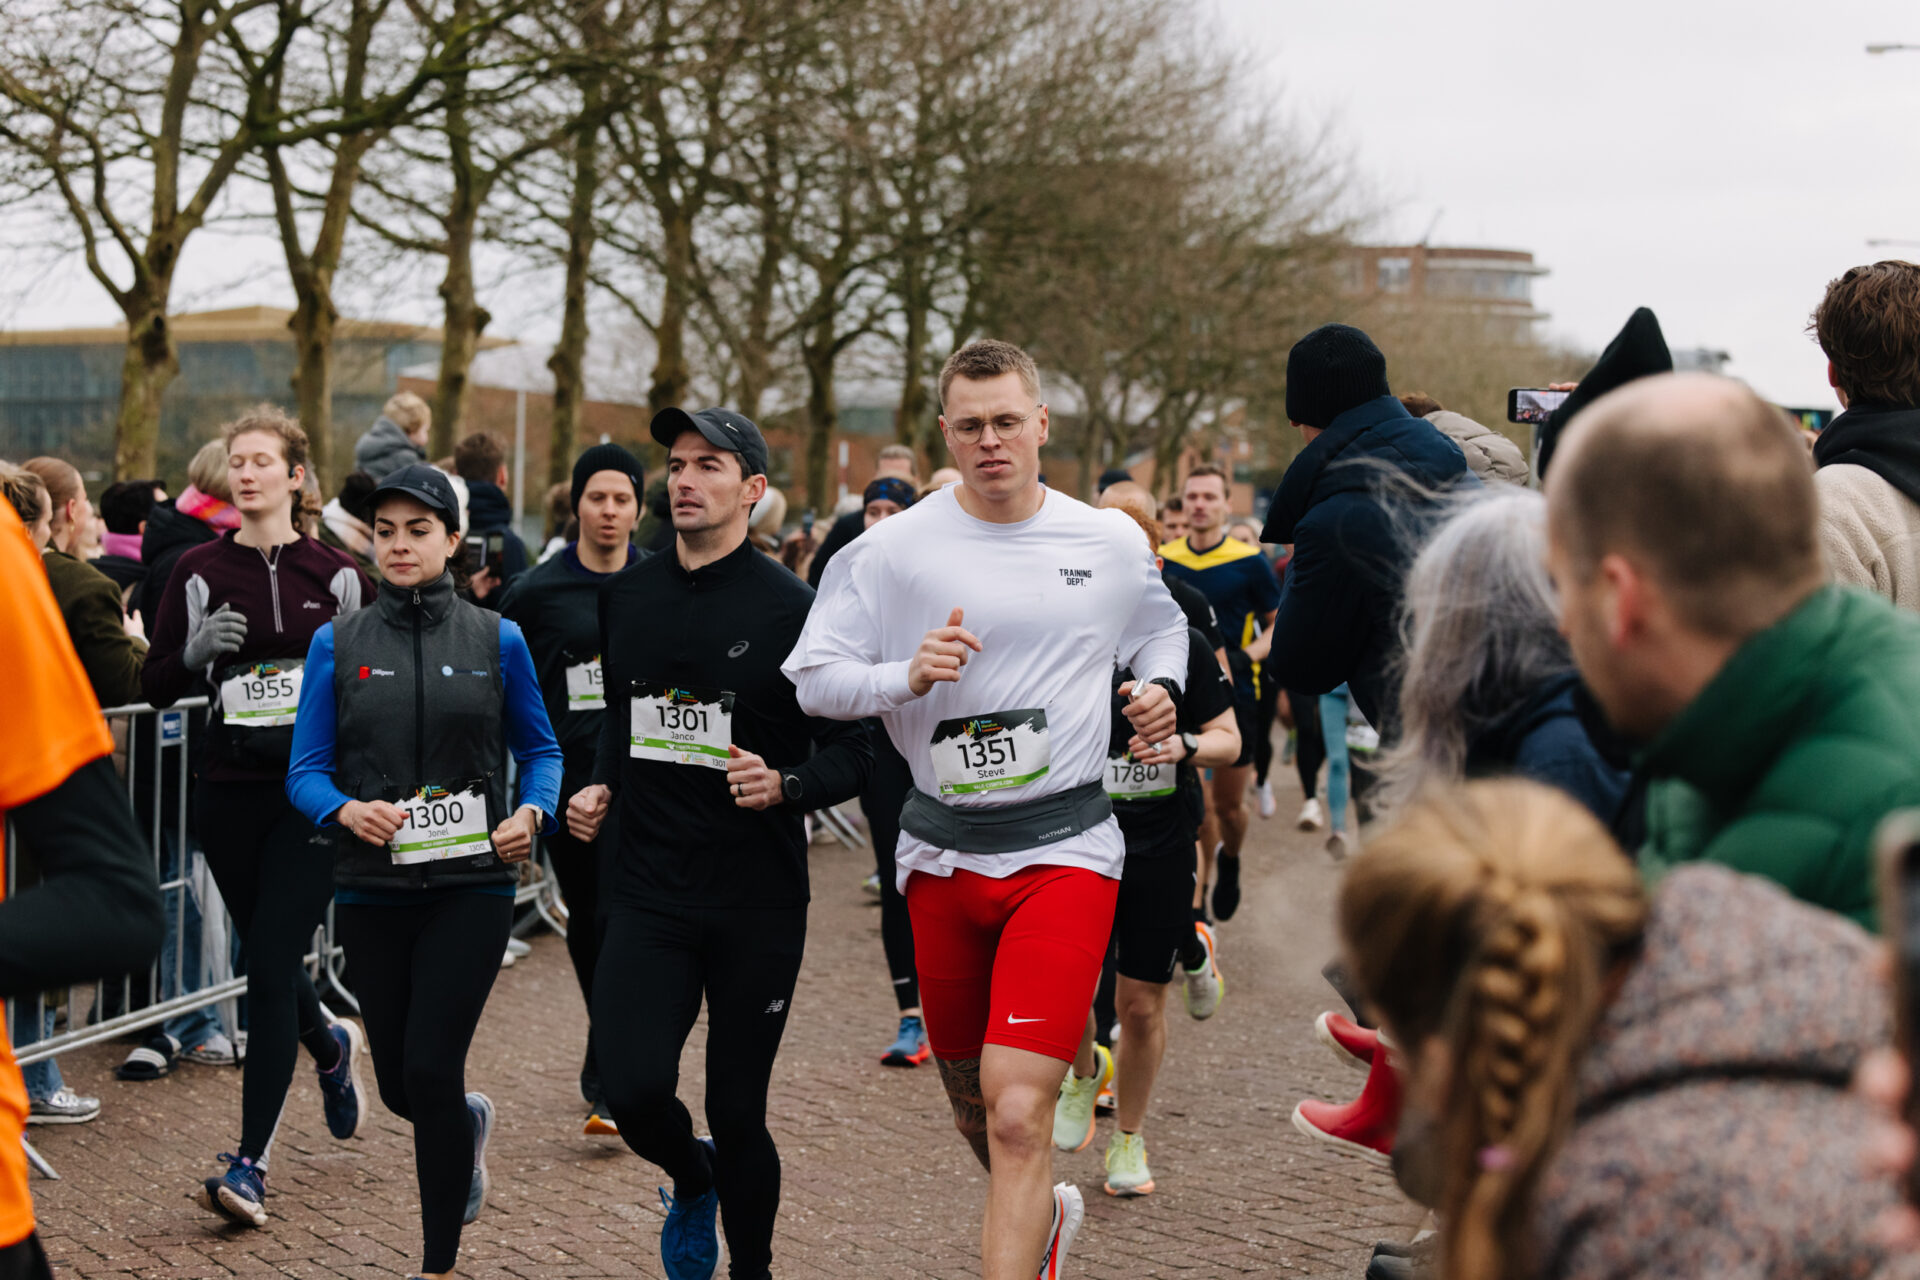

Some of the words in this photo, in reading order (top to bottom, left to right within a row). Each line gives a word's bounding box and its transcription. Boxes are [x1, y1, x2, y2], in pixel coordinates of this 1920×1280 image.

[1059, 568, 1092, 578] TRAINING
[1066, 578, 1087, 587] DEPT.
[242, 678, 293, 700] 1955
[656, 705, 708, 732] 1301
[671, 731, 695, 741] Janco
[957, 737, 1016, 769] 1351
[712, 759, 726, 767] 1301
[977, 768, 1005, 778] Steve
[1112, 764, 1159, 783] 1780
[405, 801, 464, 829] 1300
[427, 828, 449, 838] Jonel
[1038, 826, 1072, 840] NATHAN
